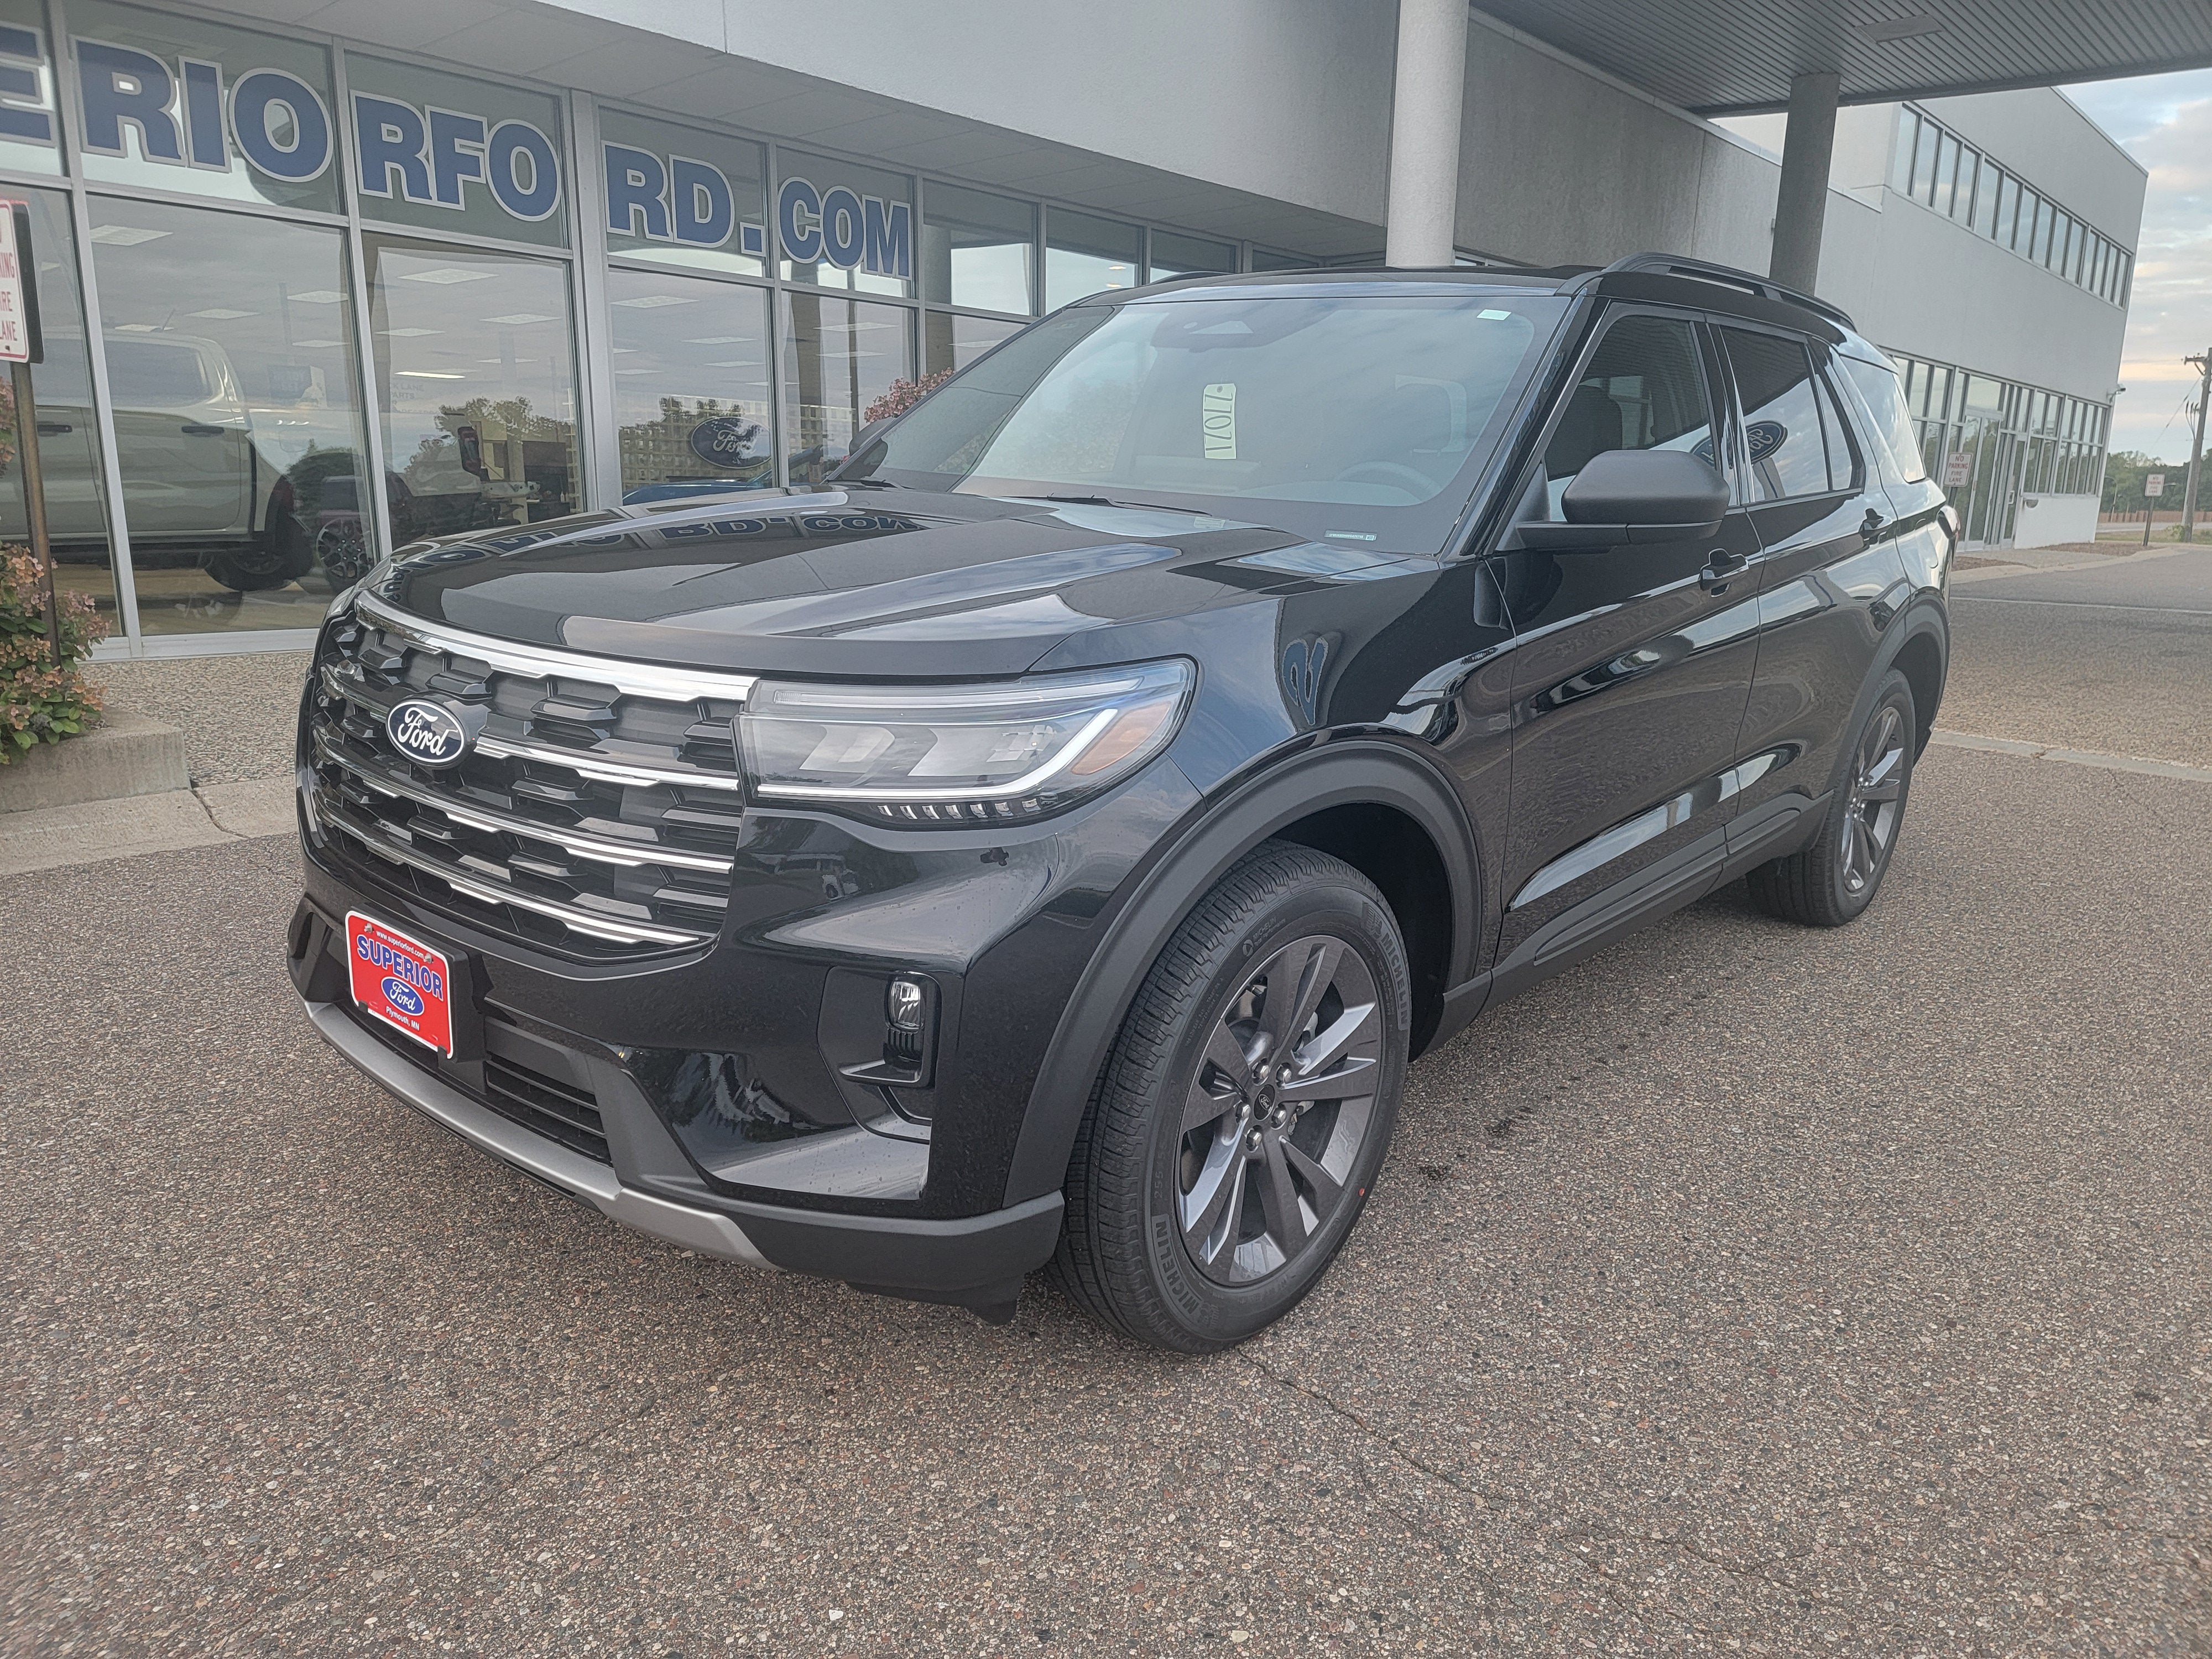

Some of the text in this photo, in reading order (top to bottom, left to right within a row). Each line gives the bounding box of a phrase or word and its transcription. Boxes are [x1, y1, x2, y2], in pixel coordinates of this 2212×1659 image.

[398, 707, 458, 756] Ford
[357, 934, 444, 1002] SUPERIOR
[375, 930, 424, 959] www.superiorford.com
[389, 981, 416, 1011] Ford
[1380, 932, 1409, 1025] MICHELIN
[386, 1005, 420, 1031] Plymouth, MN
[1155, 1220, 1200, 1314] MICHELIN
